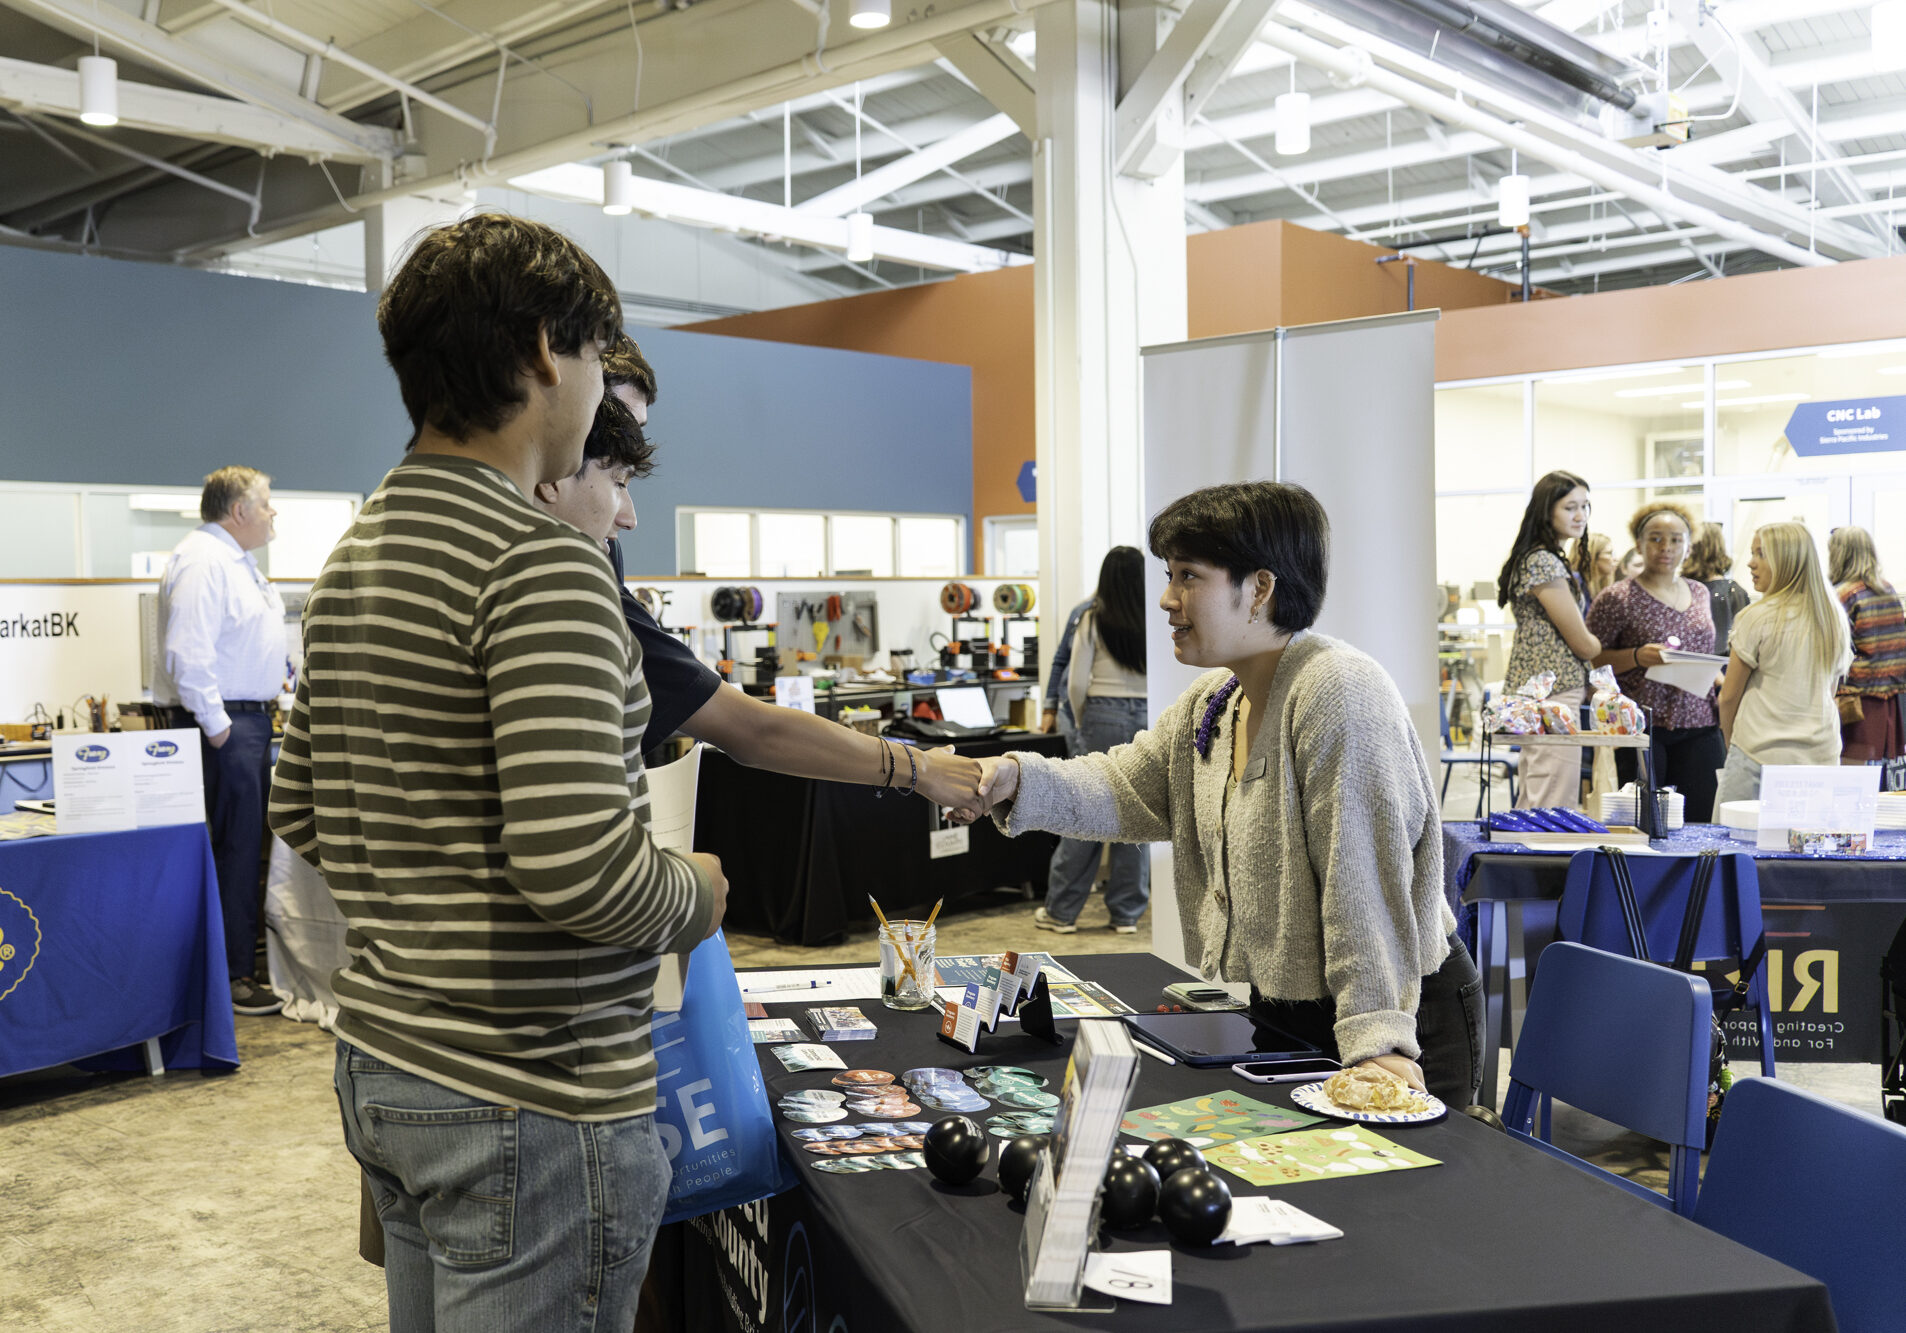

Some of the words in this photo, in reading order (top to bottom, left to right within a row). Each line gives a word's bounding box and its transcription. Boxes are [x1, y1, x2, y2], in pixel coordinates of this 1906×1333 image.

[1826, 408, 1855, 423] CNC
[1856, 406, 1881, 420] Lab
[671, 1148, 736, 1178] ortunities
[686, 1167, 732, 1189] People
